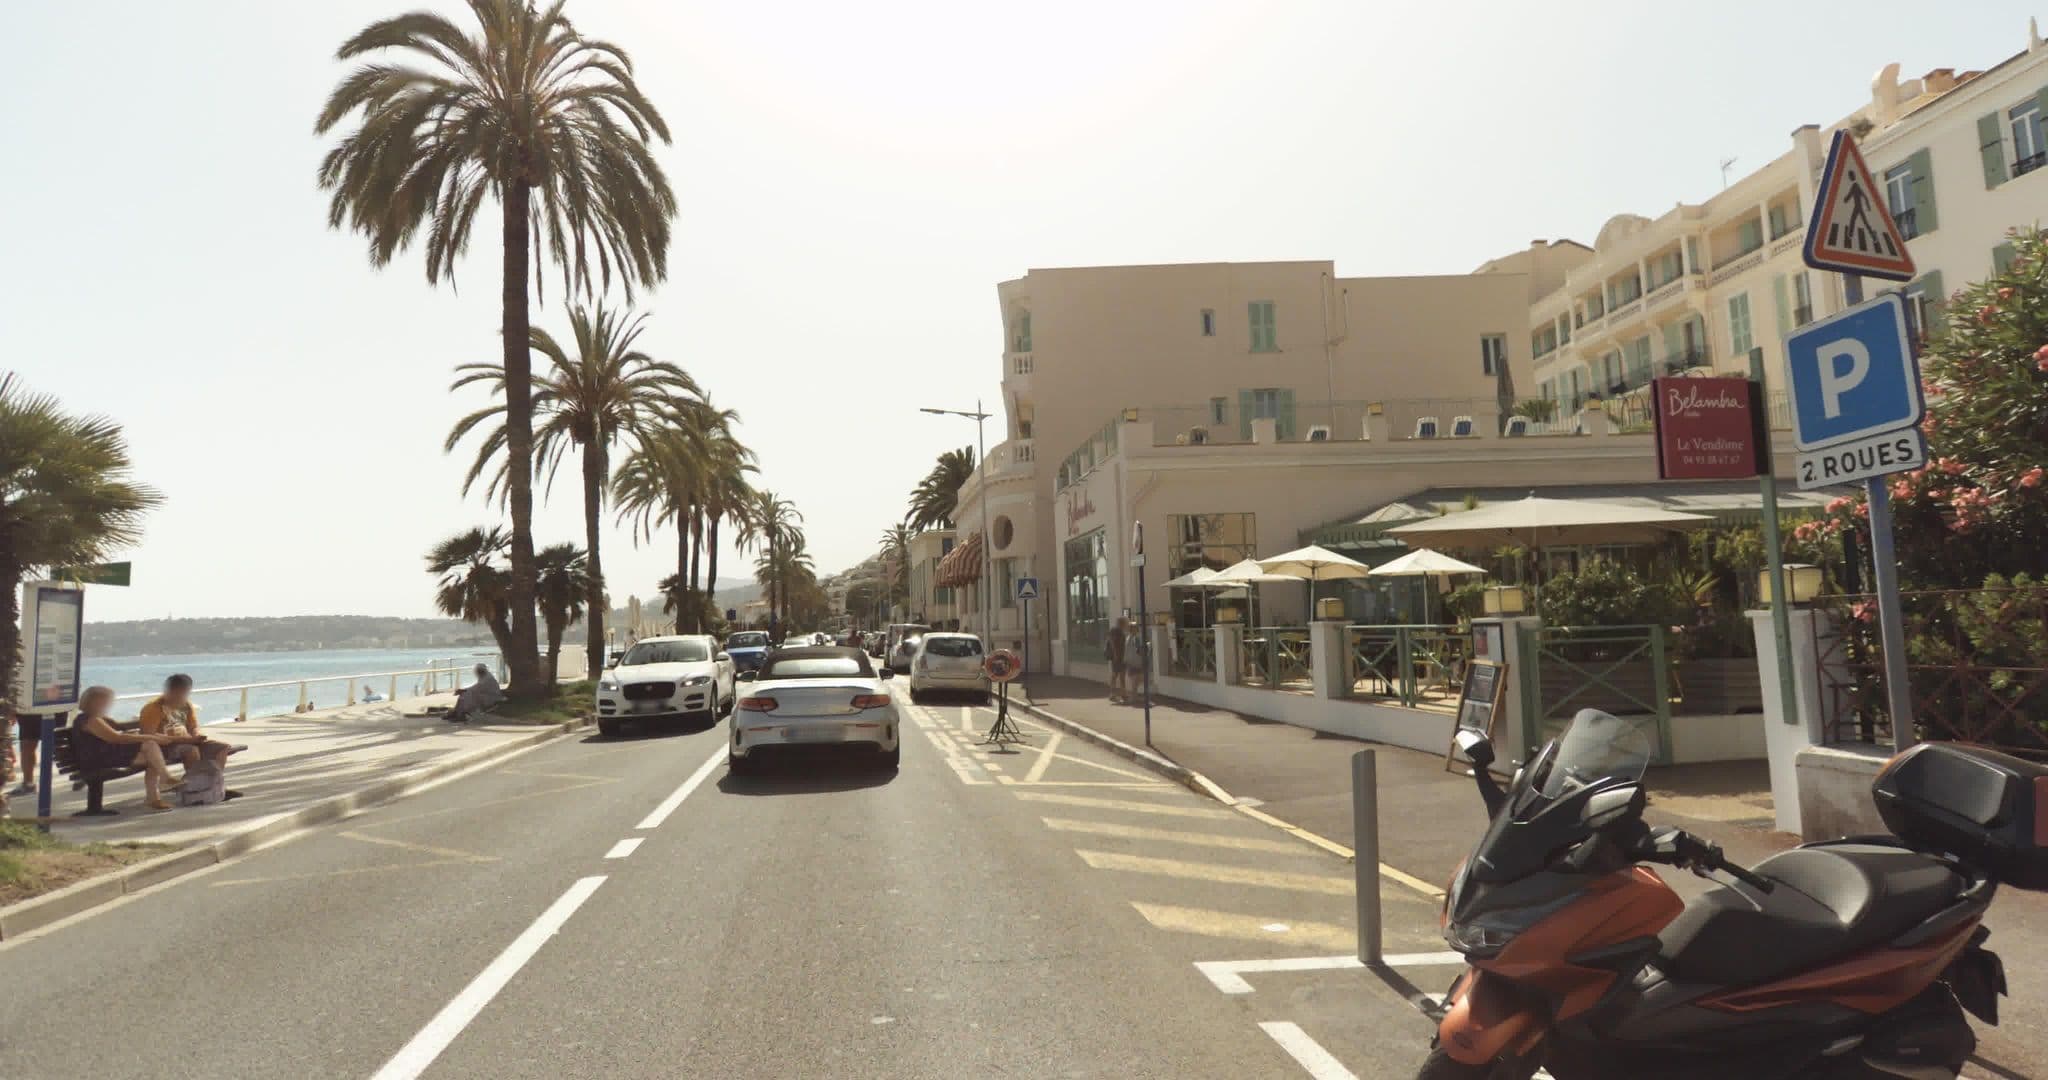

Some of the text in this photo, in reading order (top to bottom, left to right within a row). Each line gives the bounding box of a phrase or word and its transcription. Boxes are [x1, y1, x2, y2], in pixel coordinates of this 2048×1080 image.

[1816, 338, 1870, 419] P
[1668, 385, 1744, 416] Belambra
[1823, 439, 1914, 478] ROUES
[1067, 488, 1097, 536] Blba
